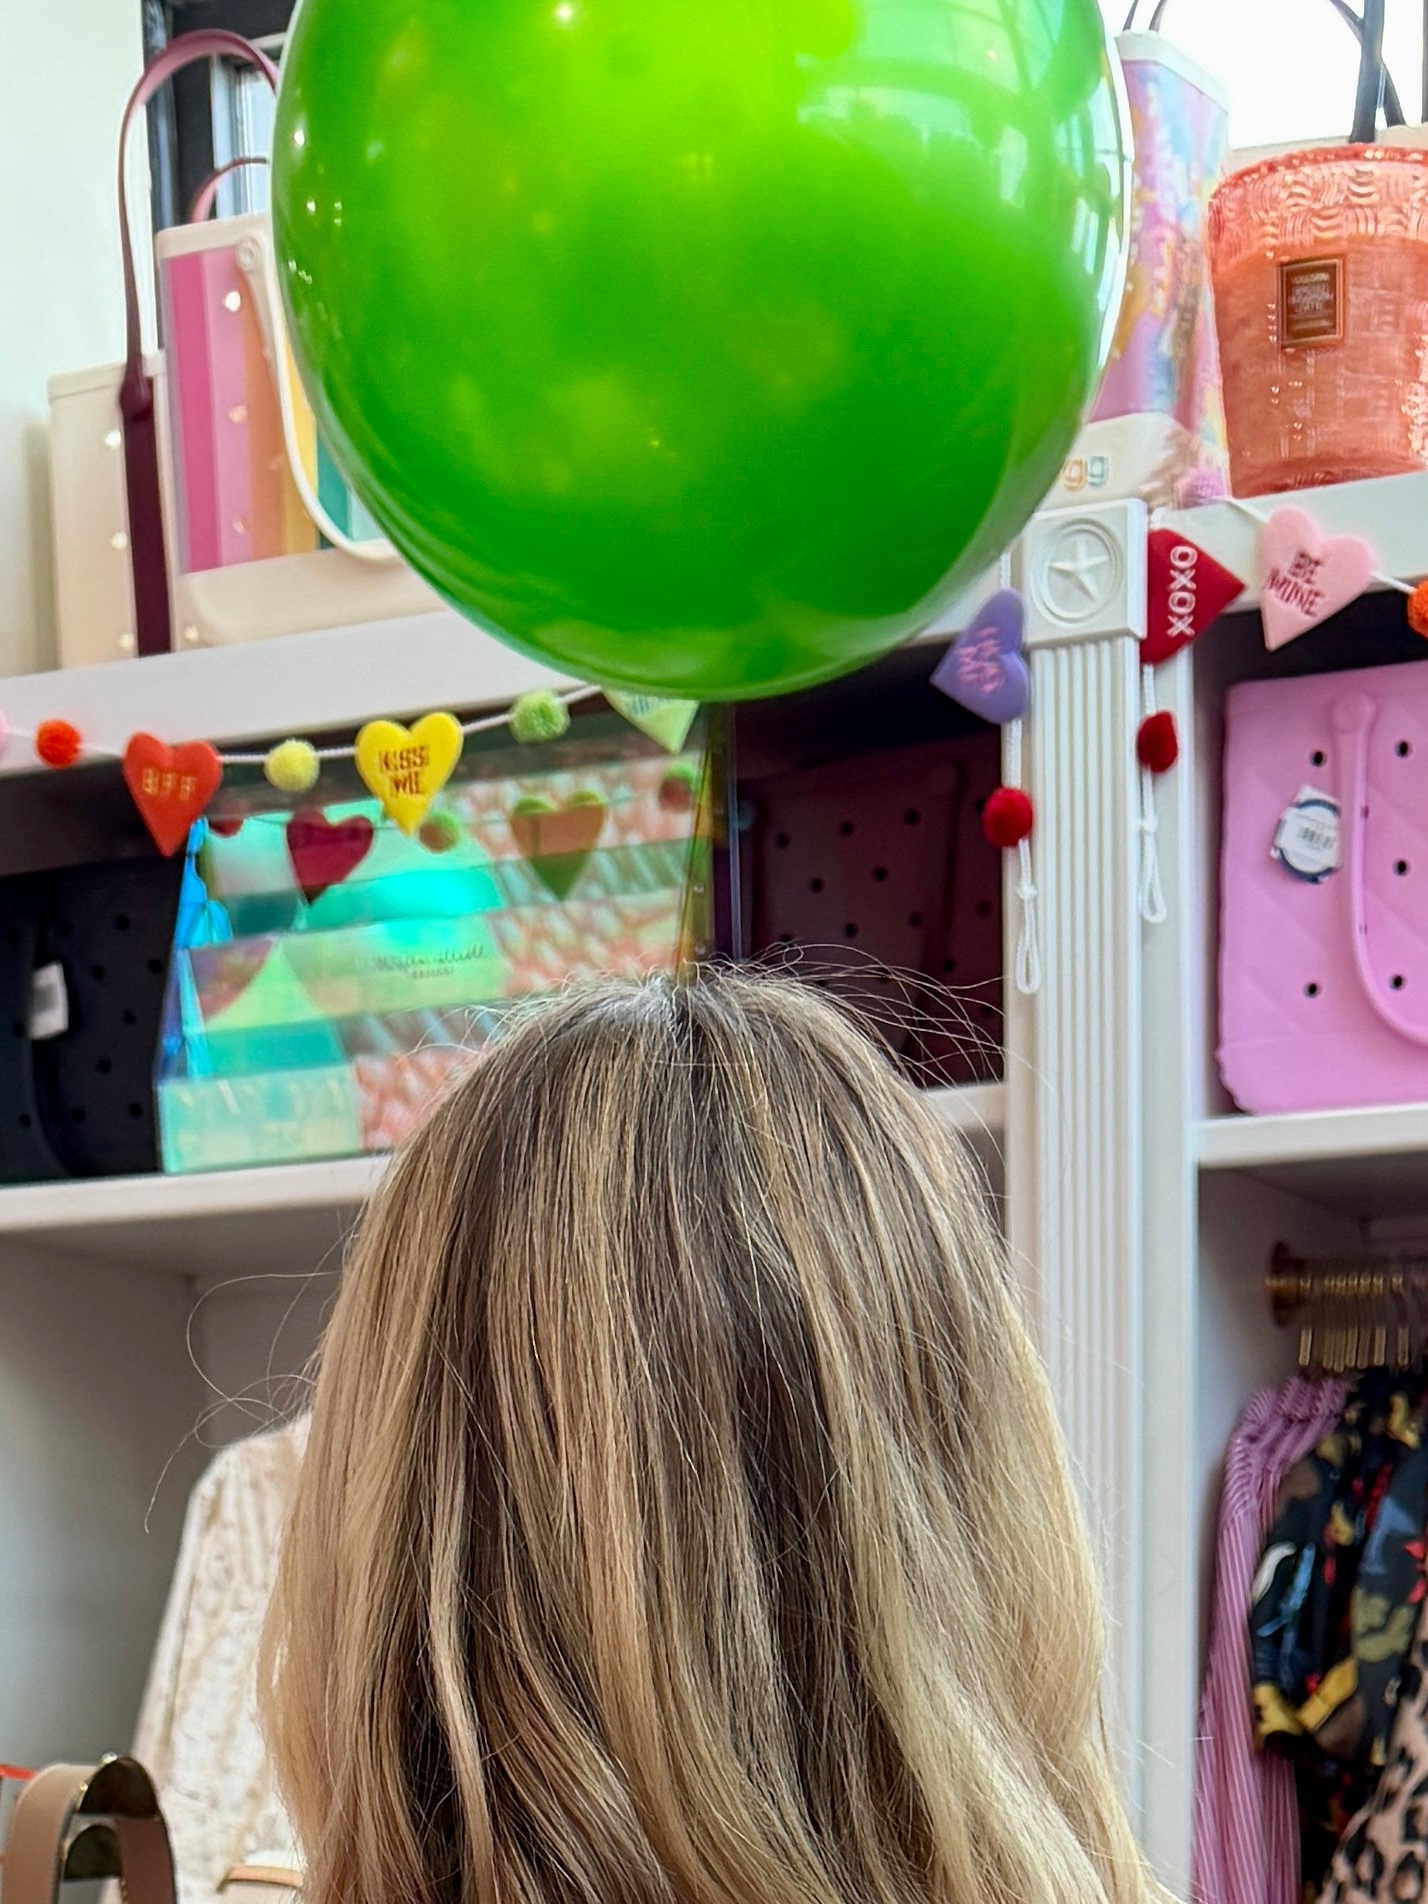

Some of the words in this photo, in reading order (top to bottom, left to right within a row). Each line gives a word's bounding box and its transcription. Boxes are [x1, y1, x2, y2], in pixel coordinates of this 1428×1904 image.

[1062, 455, 1109, 491] gg
[1287, 551, 1325, 586] BE
[1166, 544, 1199, 639] XOXO
[1265, 567, 1326, 618] MINE
[140, 766, 197, 802] BFF
